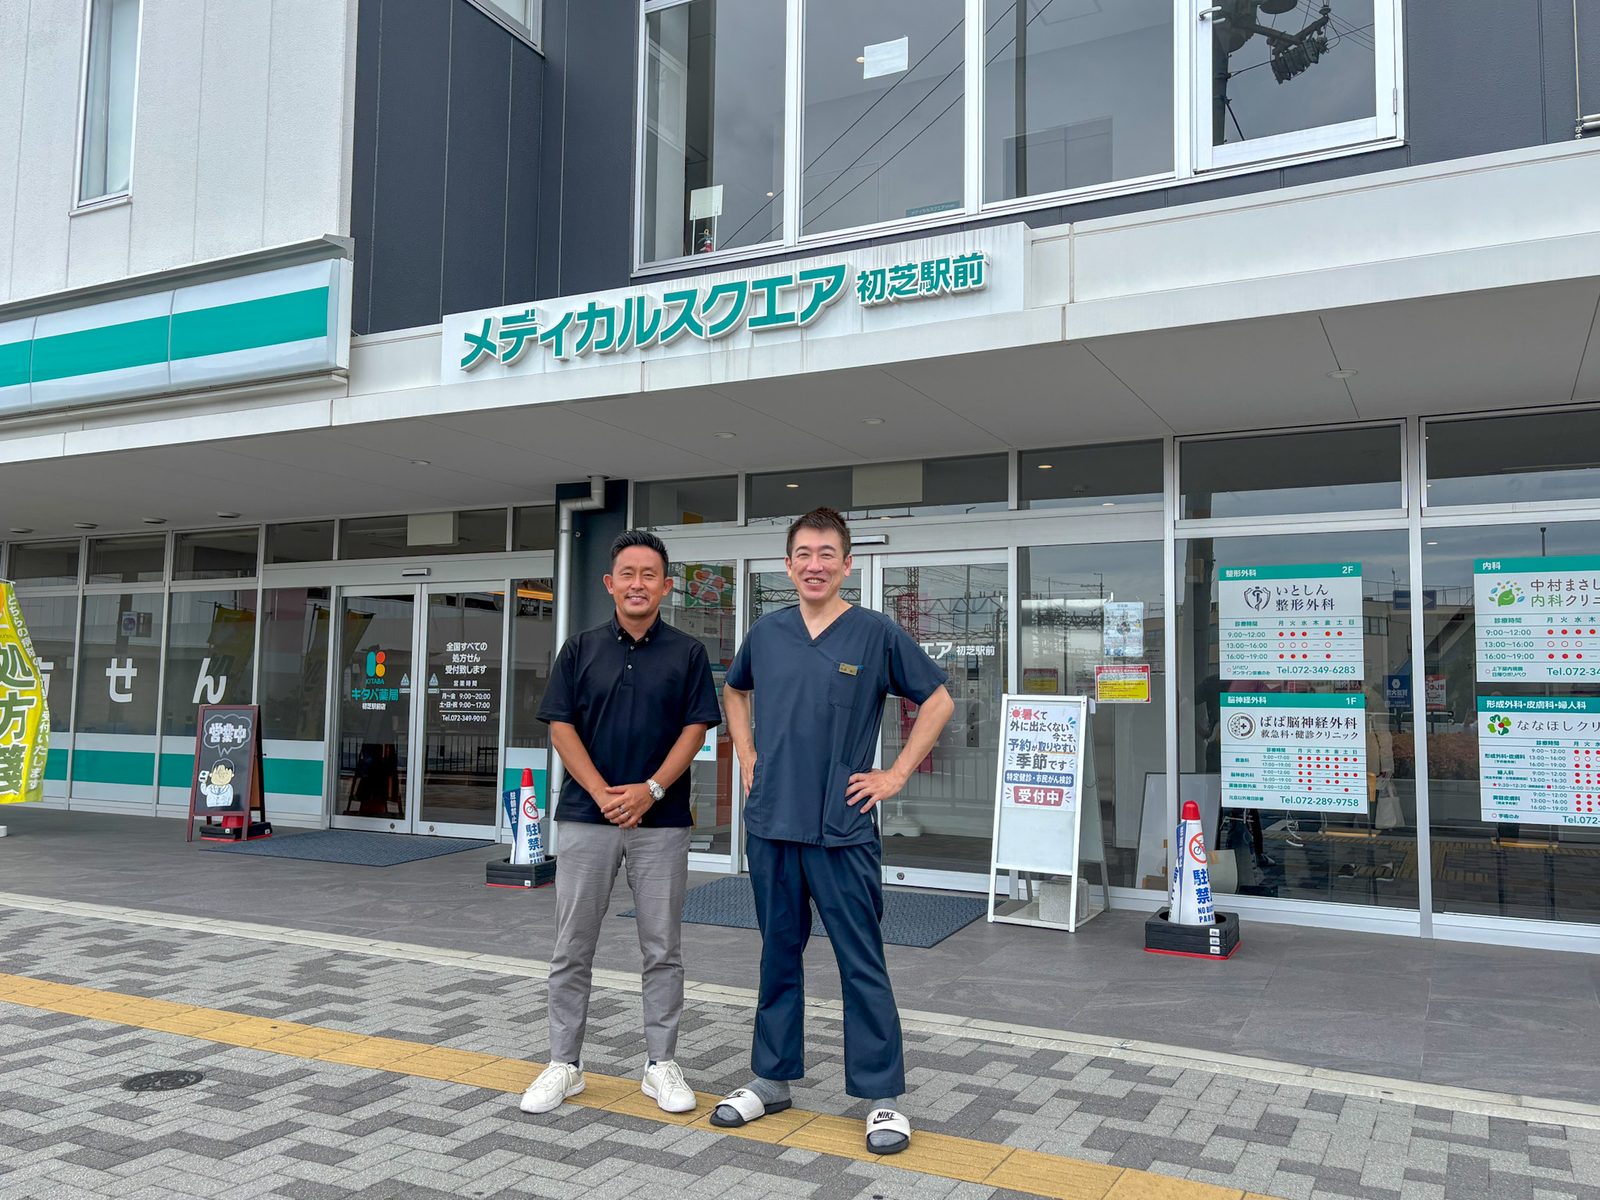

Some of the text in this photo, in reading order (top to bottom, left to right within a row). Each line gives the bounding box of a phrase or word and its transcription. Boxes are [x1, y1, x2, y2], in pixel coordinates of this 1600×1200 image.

[460, 252, 985, 369] メディカルスクエア 初芝駅前
[1482, 561, 1501, 570] 内科
[1225, 566, 1354, 578] 整形外科 2F
[1276, 584, 1328, 596] いとしん
[1276, 598, 1335, 612] 整形外科
[446, 642, 488, 652] 全国すべての
[956, 645, 995, 656] 初芝駅前
[452, 654, 480, 663] 処方せん
[445, 665, 487, 675] 受付致します
[1276, 666, 1356, 674] Tel.072-349-6283
[351, 688, 399, 701] キタバ薬局
[1227, 696, 1357, 705] 脳神経外科 1F
[1486, 700, 1587, 710] 形成外科・皮膚科・婦人科
[1010, 720, 1070, 732] 外に出たくない
[1260, 716, 1358, 730] ばば脳神経外科
[209, 722, 246, 743] 営業中
[1260, 729, 1359, 740] 救急科・健診クリニック
[1008, 738, 1076, 752] 予約が取りやすい
[1016, 753, 1067, 771] 季節です
[1018, 788, 1060, 804] 受付中
[1280, 796, 1359, 807] Tel.072-289-9758
[1193, 868, 1210, 886] 駐
[877, 1111, 896, 1119] NIKE
